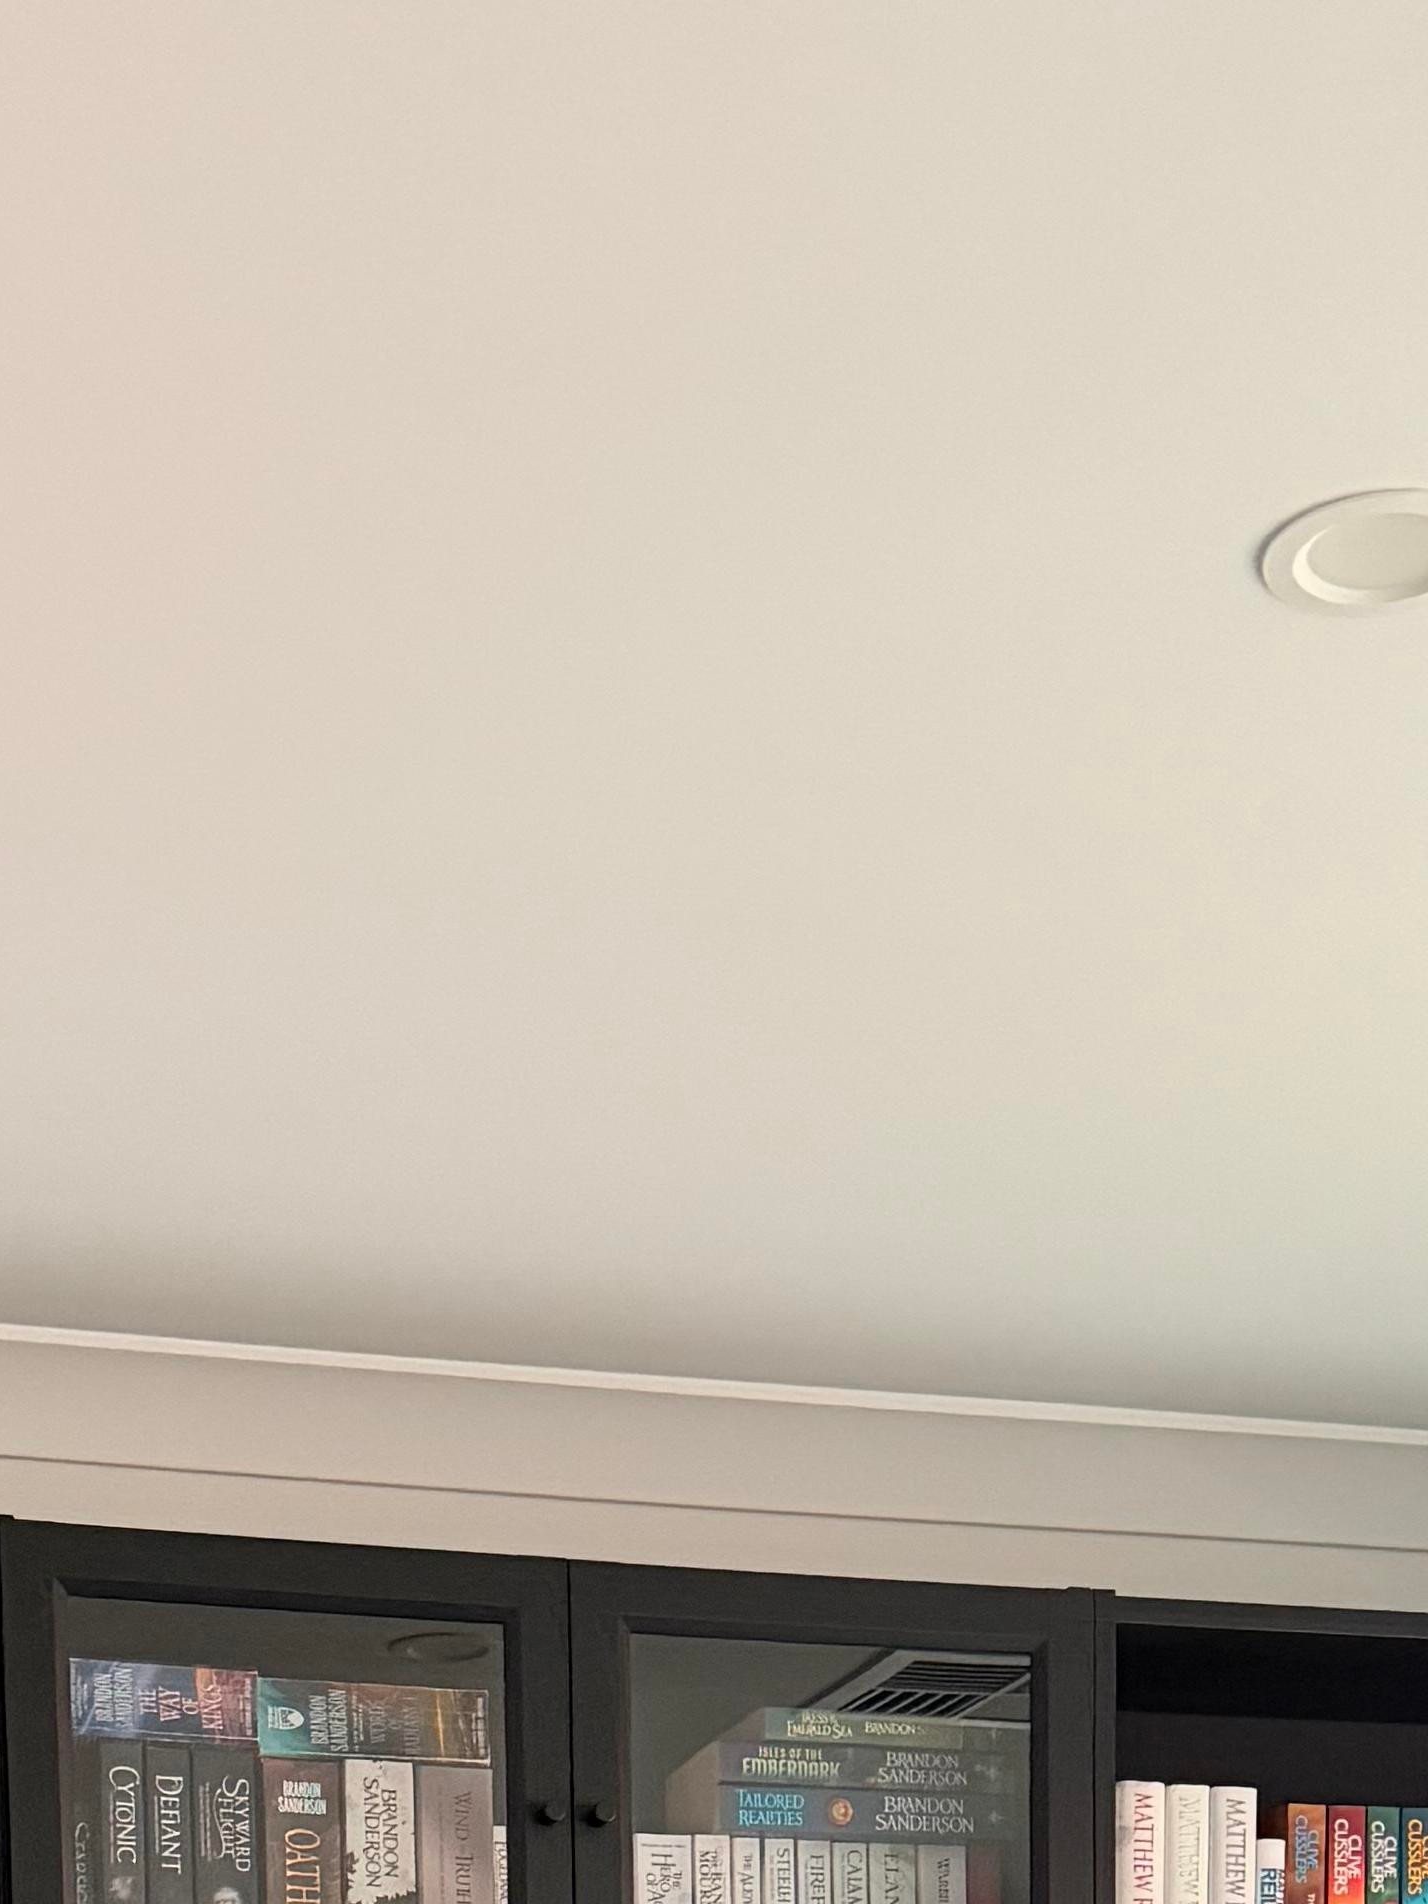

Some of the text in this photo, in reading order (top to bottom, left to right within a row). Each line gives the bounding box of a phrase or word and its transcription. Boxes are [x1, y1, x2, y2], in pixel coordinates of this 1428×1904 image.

[887, 1752, 959, 1767] BRANDON
[878, 1768, 967, 1785] SANDERSON
[737, 1790, 804, 1809] TAILORED
[884, 1797, 964, 1814] BRANDON
[156, 1775, 183, 1873] DEFIANT
[875, 1815, 974, 1833] SANDERSON
[1133, 1793, 1154, 1893] MATTHEW
[1225, 1799, 1245, 1896] MATTHEW
